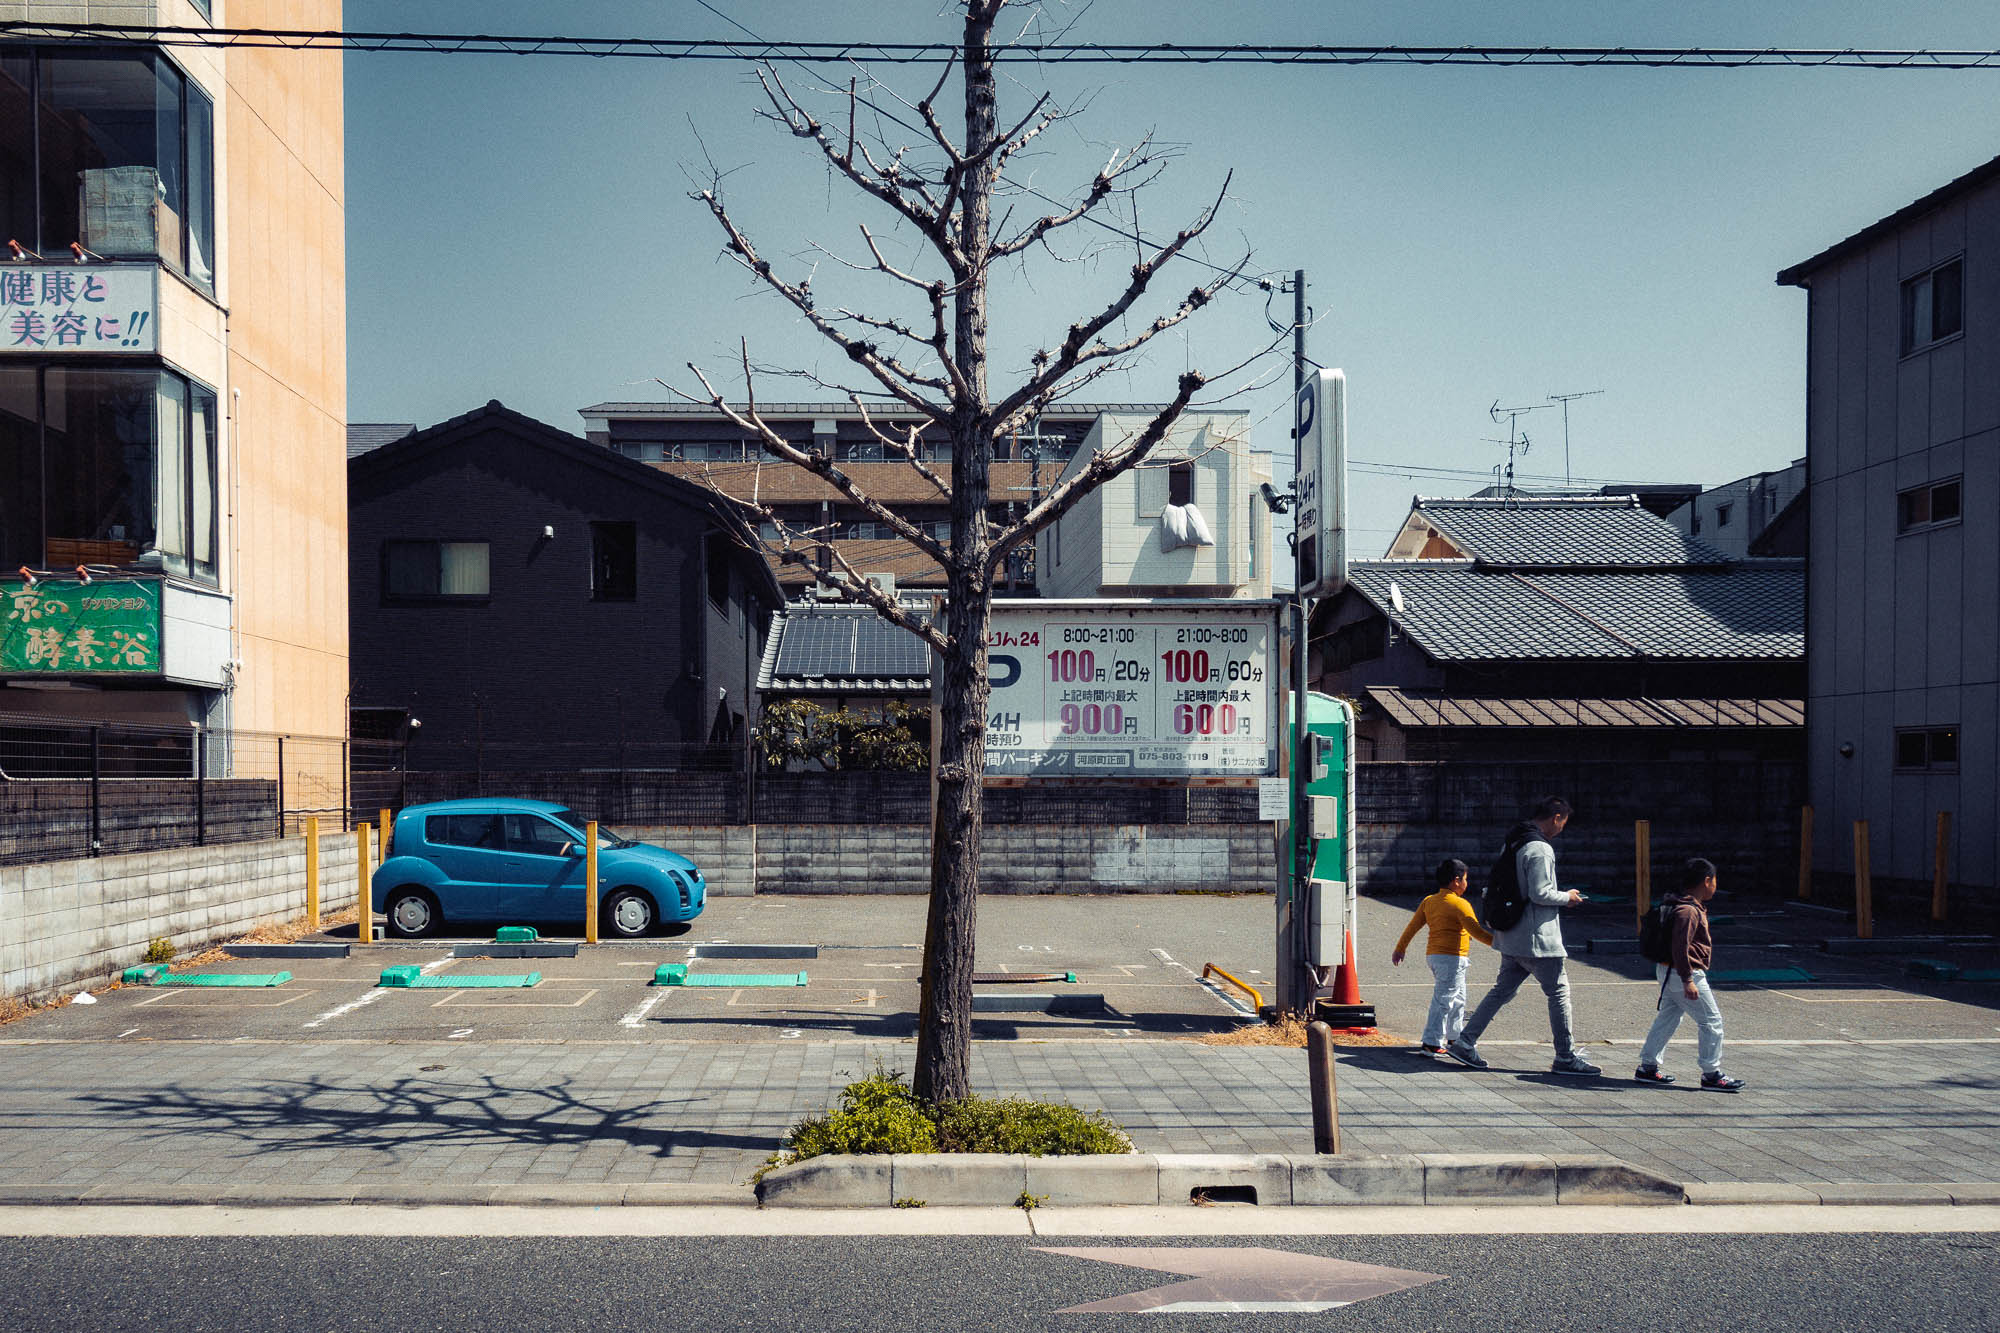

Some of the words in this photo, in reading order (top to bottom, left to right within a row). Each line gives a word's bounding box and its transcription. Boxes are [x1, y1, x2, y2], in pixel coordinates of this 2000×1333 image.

[0, 271, 105, 306] 健康と
[9, 585, 69, 622] 京の
[26, 626, 150, 668] 酵素浴
[1060, 689, 1139, 702] 上記時間内最大
[1173, 689, 1251, 702] 上記時間内最大
[1060, 703, 1138, 735] 900円
[1173, 703, 1251, 735] 600円
[984, 751, 1070, 767] 間パーキング
